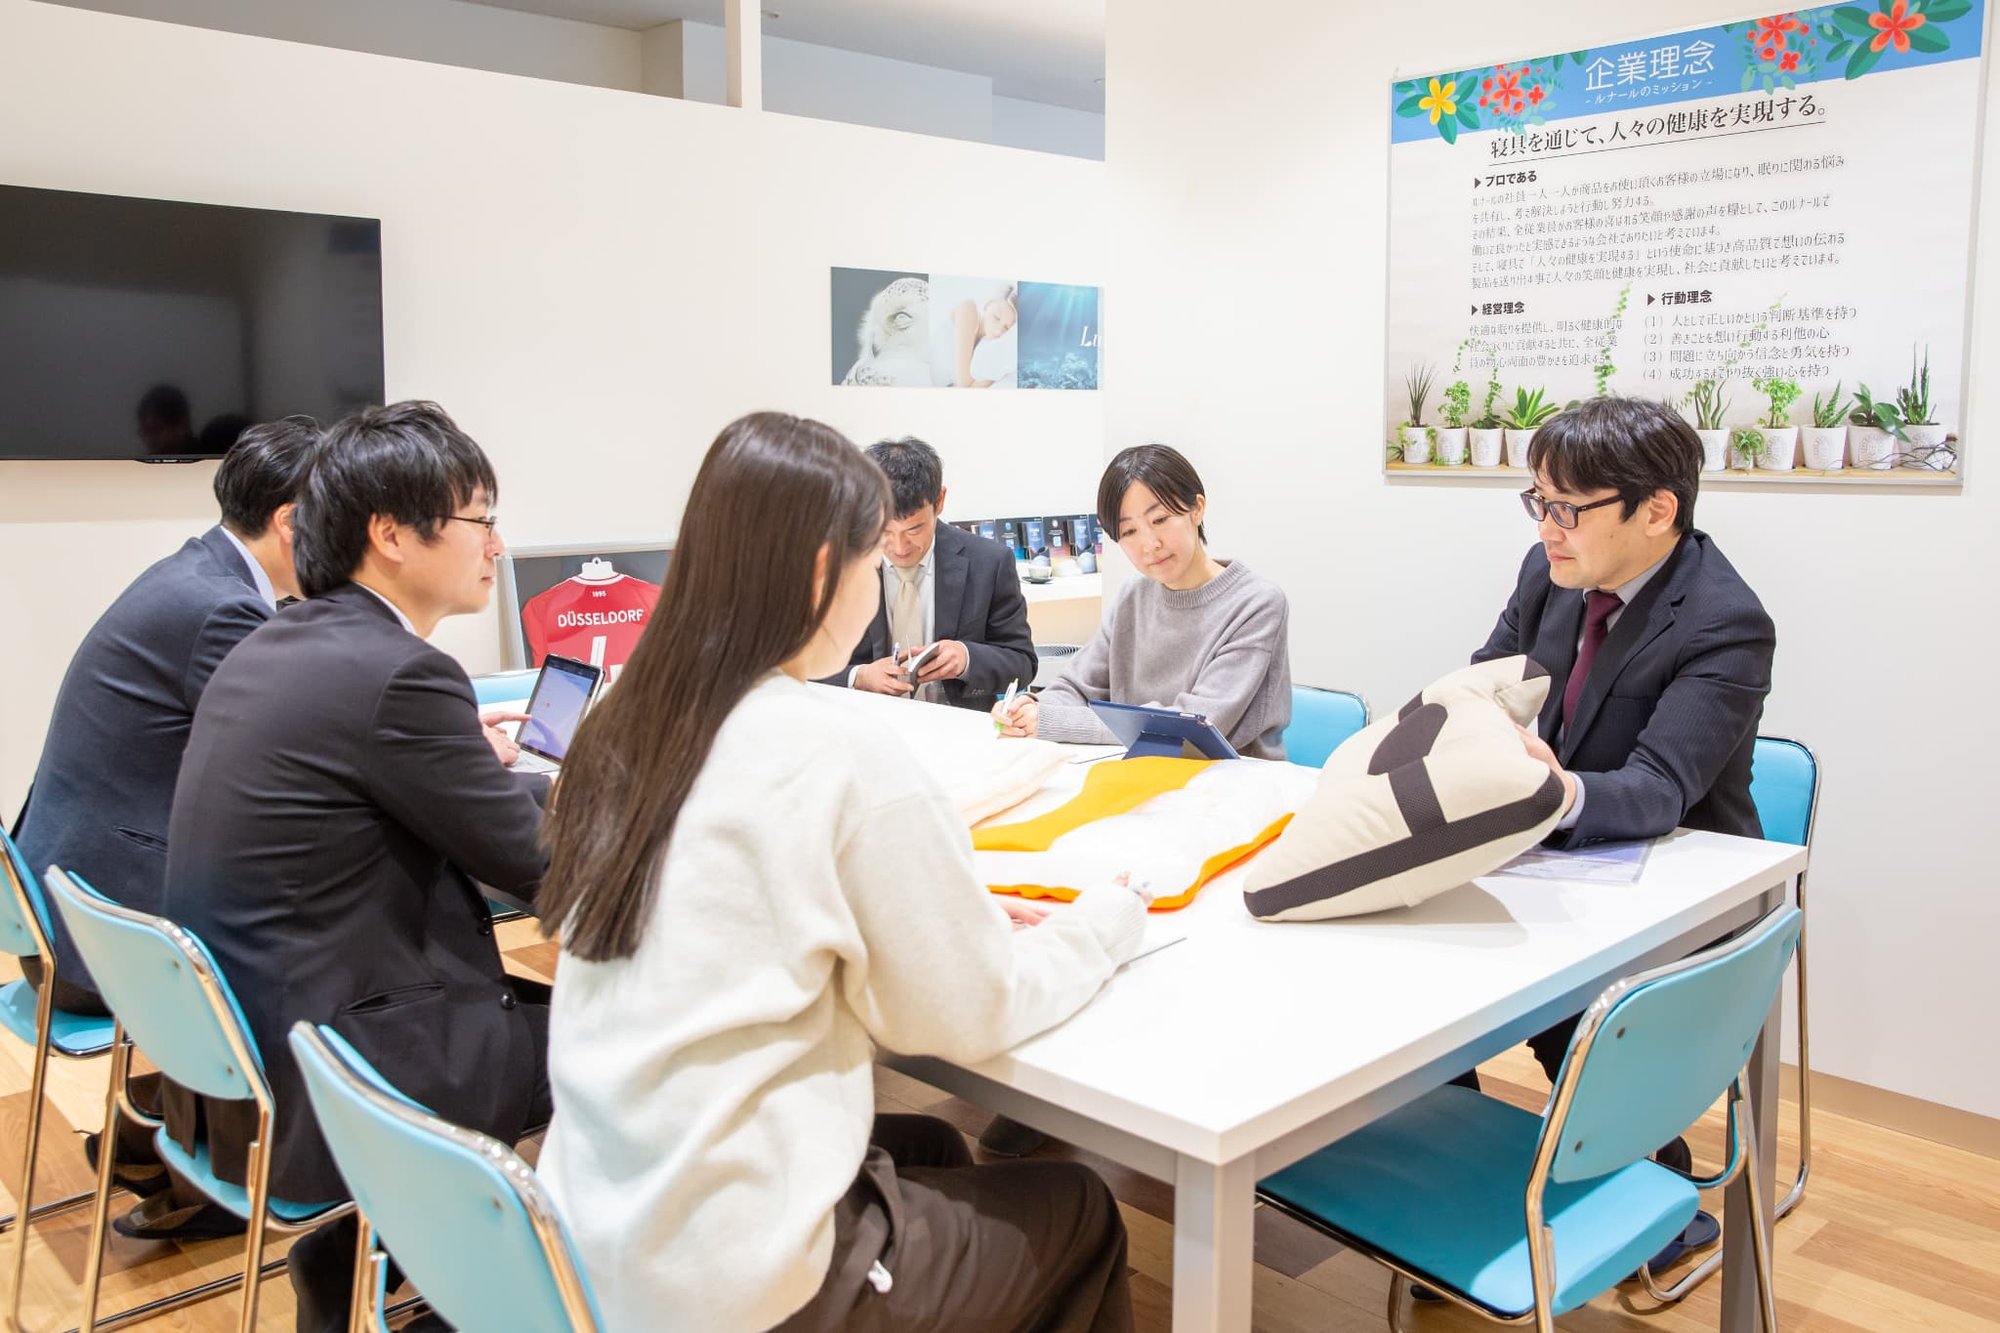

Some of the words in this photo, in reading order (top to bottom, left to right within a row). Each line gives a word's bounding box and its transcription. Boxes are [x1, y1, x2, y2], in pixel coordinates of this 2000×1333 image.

[1585, 39, 1716, 91] 企業理念
[1491, 94, 1825, 158] 寝具を通じて、人々の健康を実現する。
[1485, 170, 1537, 187] プロである
[1661, 289, 1713, 305] 行動理念
[1482, 301, 1525, 315] 経営理念
[557, 608, 645, 628] DÜSSELDORF
